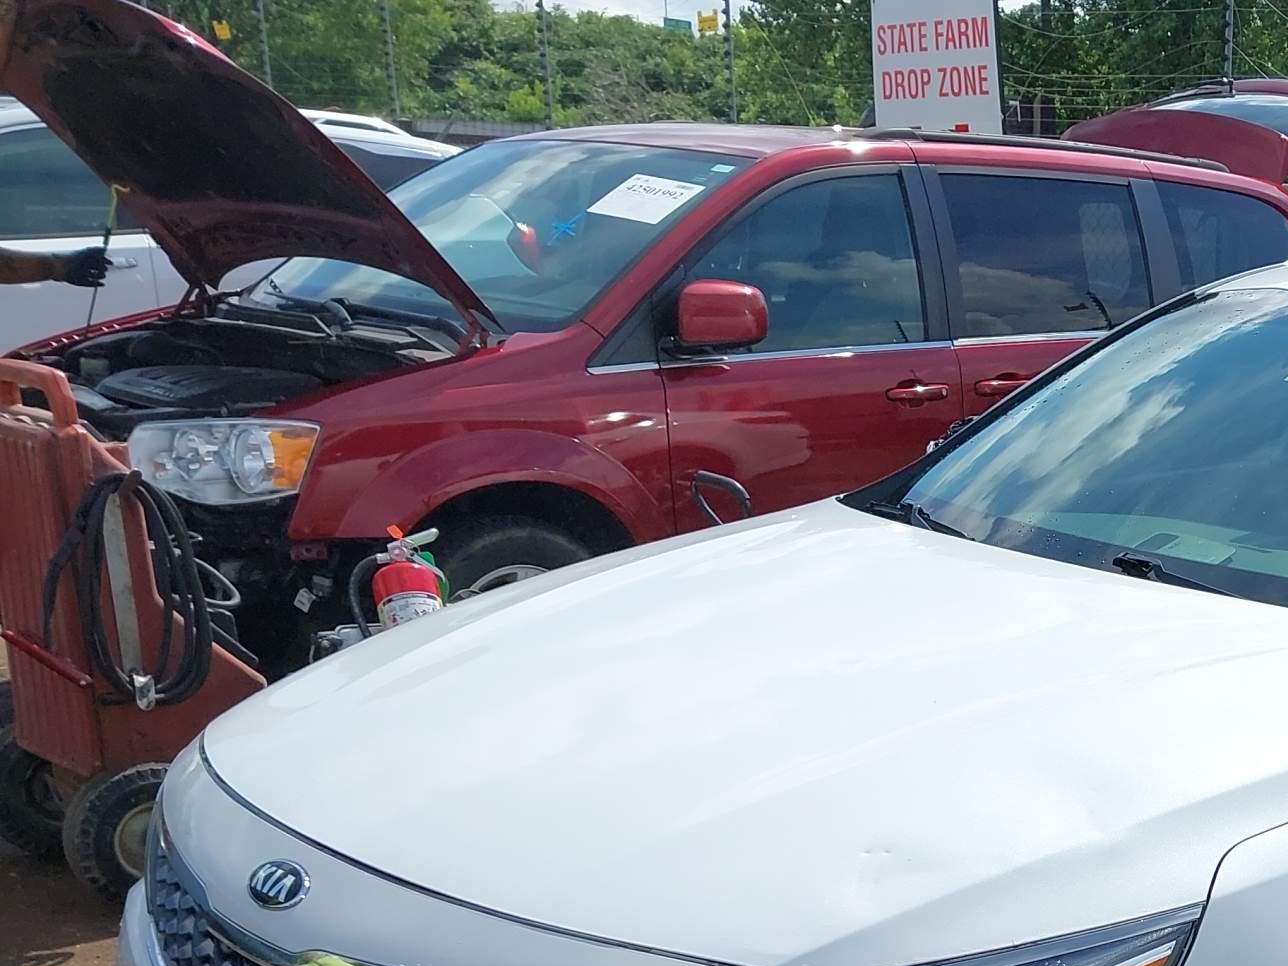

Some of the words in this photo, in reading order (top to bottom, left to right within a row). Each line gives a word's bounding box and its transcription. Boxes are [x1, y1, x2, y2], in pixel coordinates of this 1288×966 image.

[877, 21, 929, 55] STATE
[934, 16, 989, 50] FARM
[882, 68, 931, 100] DROP
[937, 64, 989, 97] ZONE
[251, 864, 296, 902] KIA
